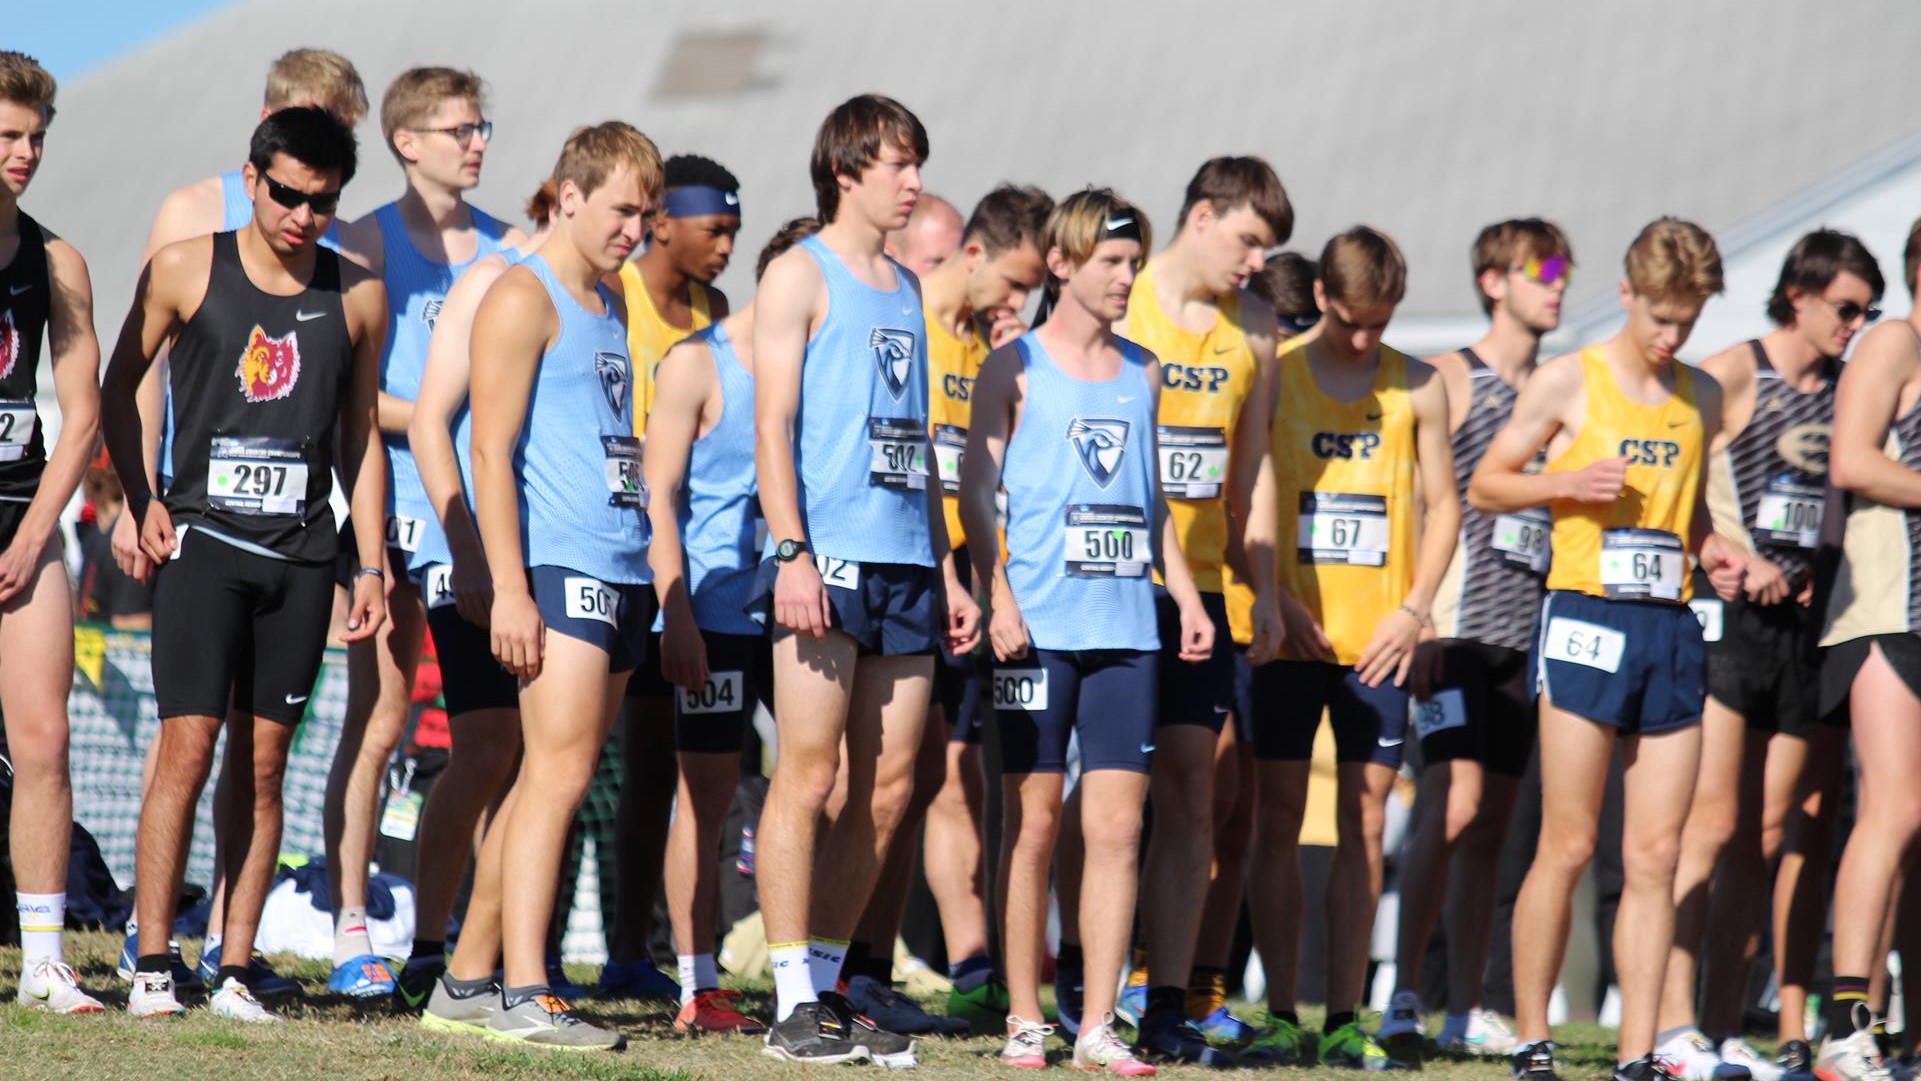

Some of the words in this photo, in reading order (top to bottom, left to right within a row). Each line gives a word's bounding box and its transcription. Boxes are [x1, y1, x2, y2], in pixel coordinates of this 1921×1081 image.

[944, 373, 976, 401] CS
[1161, 363, 1229, 393] CSP
[1312, 432, 1380, 460] CSP
[1619, 438, 1680, 467] CSP
[1169, 452, 1203, 480] 62
[233, 465, 287, 497] 297
[1784, 502, 1818, 530] 100
[1085, 530, 1133, 559] 500
[1332, 518, 1361, 547] 67
[1633, 552, 1662, 582] 64
[436, 573, 455, 599] 4
[580, 586, 613, 617] 50
[1566, 630, 1602, 661] 64
[687, 678, 735, 710] 504
[994, 676, 1034, 705] 500
